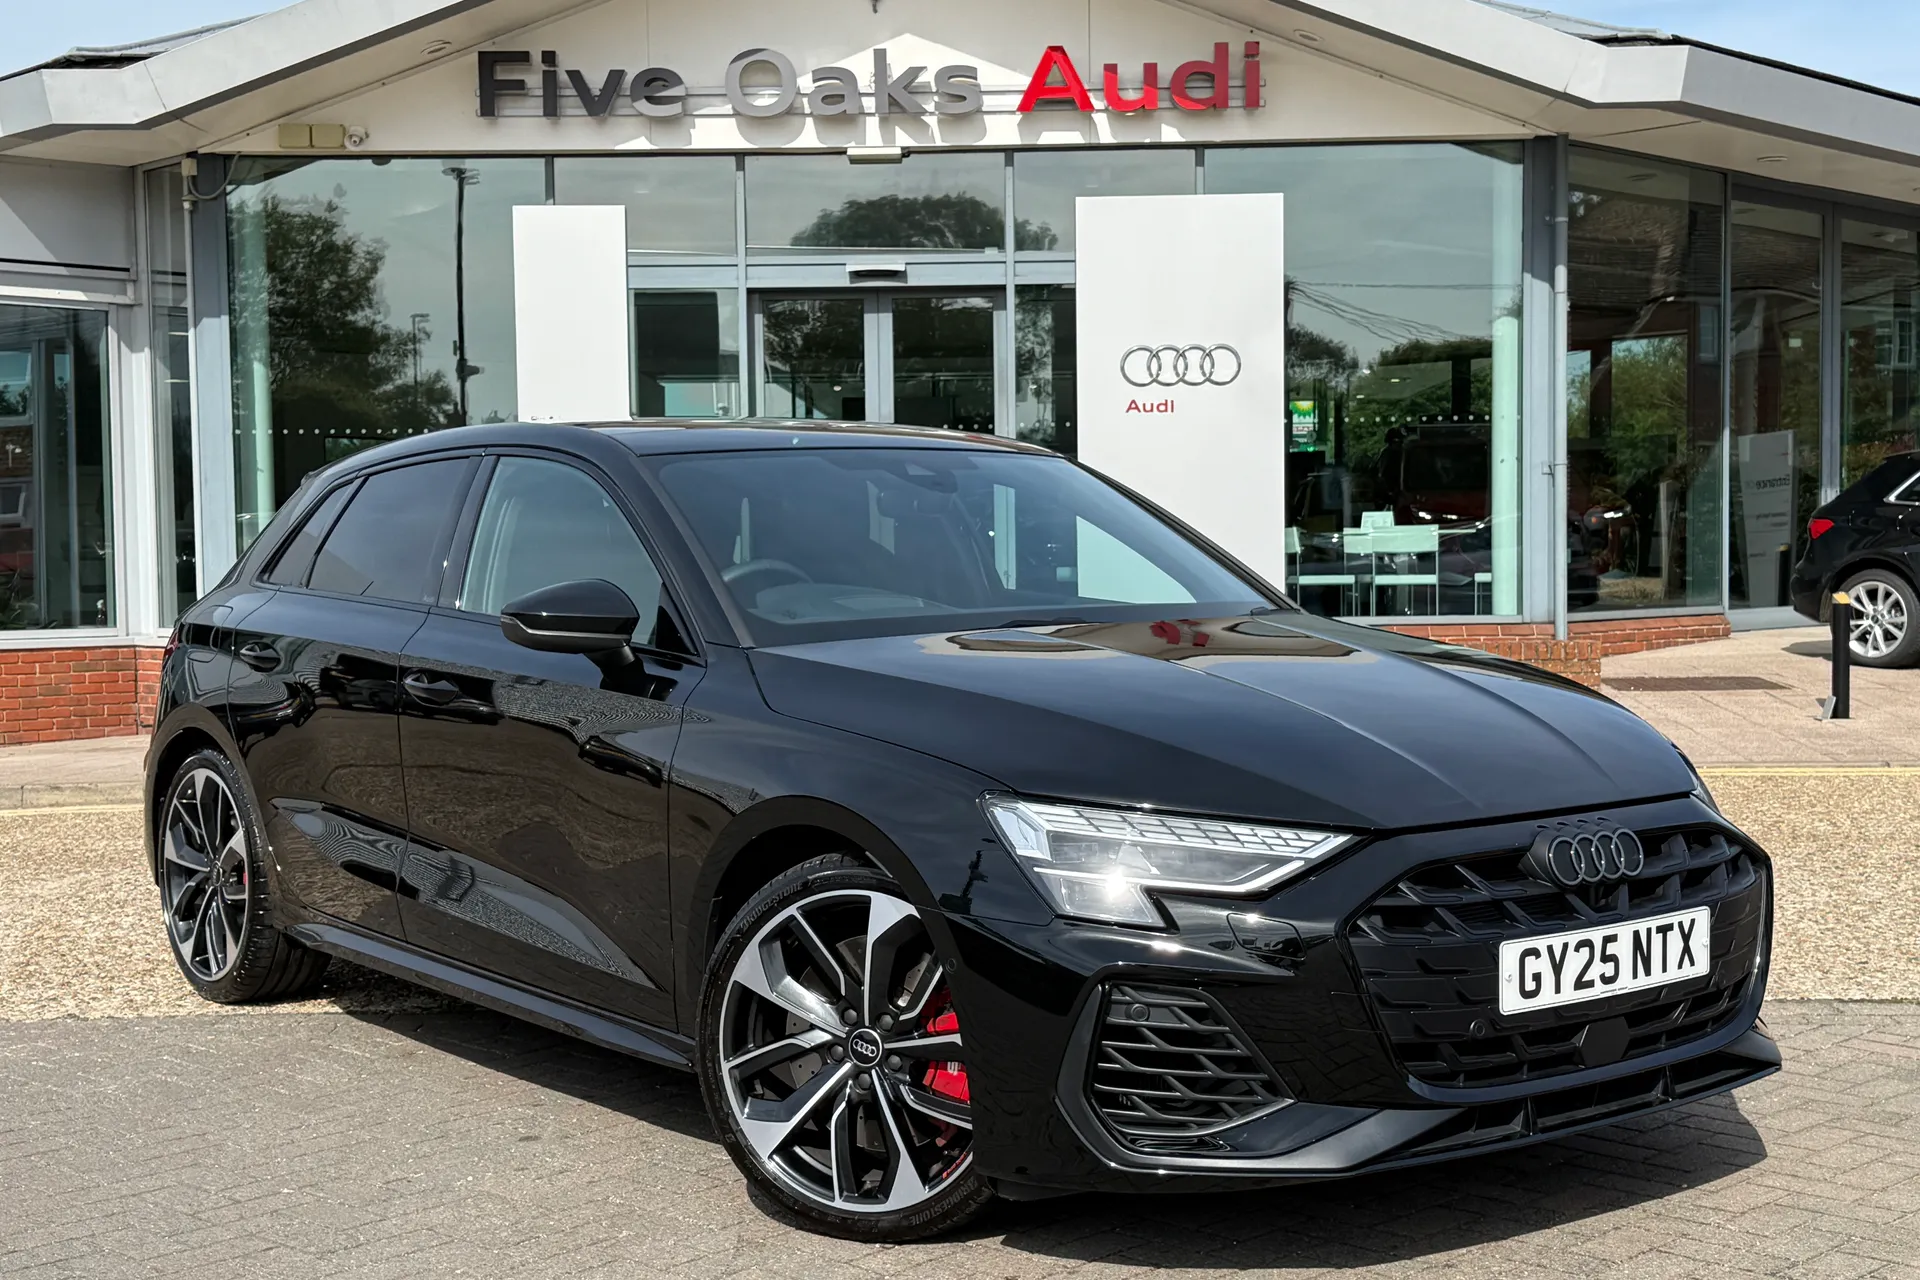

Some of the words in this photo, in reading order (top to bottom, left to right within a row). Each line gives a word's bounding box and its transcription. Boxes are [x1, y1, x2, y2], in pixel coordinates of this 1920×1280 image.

[478, 50, 687, 118] Five
[725, 48, 983, 118] Oaks
[1016, 41, 1261, 112] Audi
[1125, 399, 1174, 413] Audi
[1518, 933, 1620, 999] GY25
[1632, 918, 1696, 980] NTX
